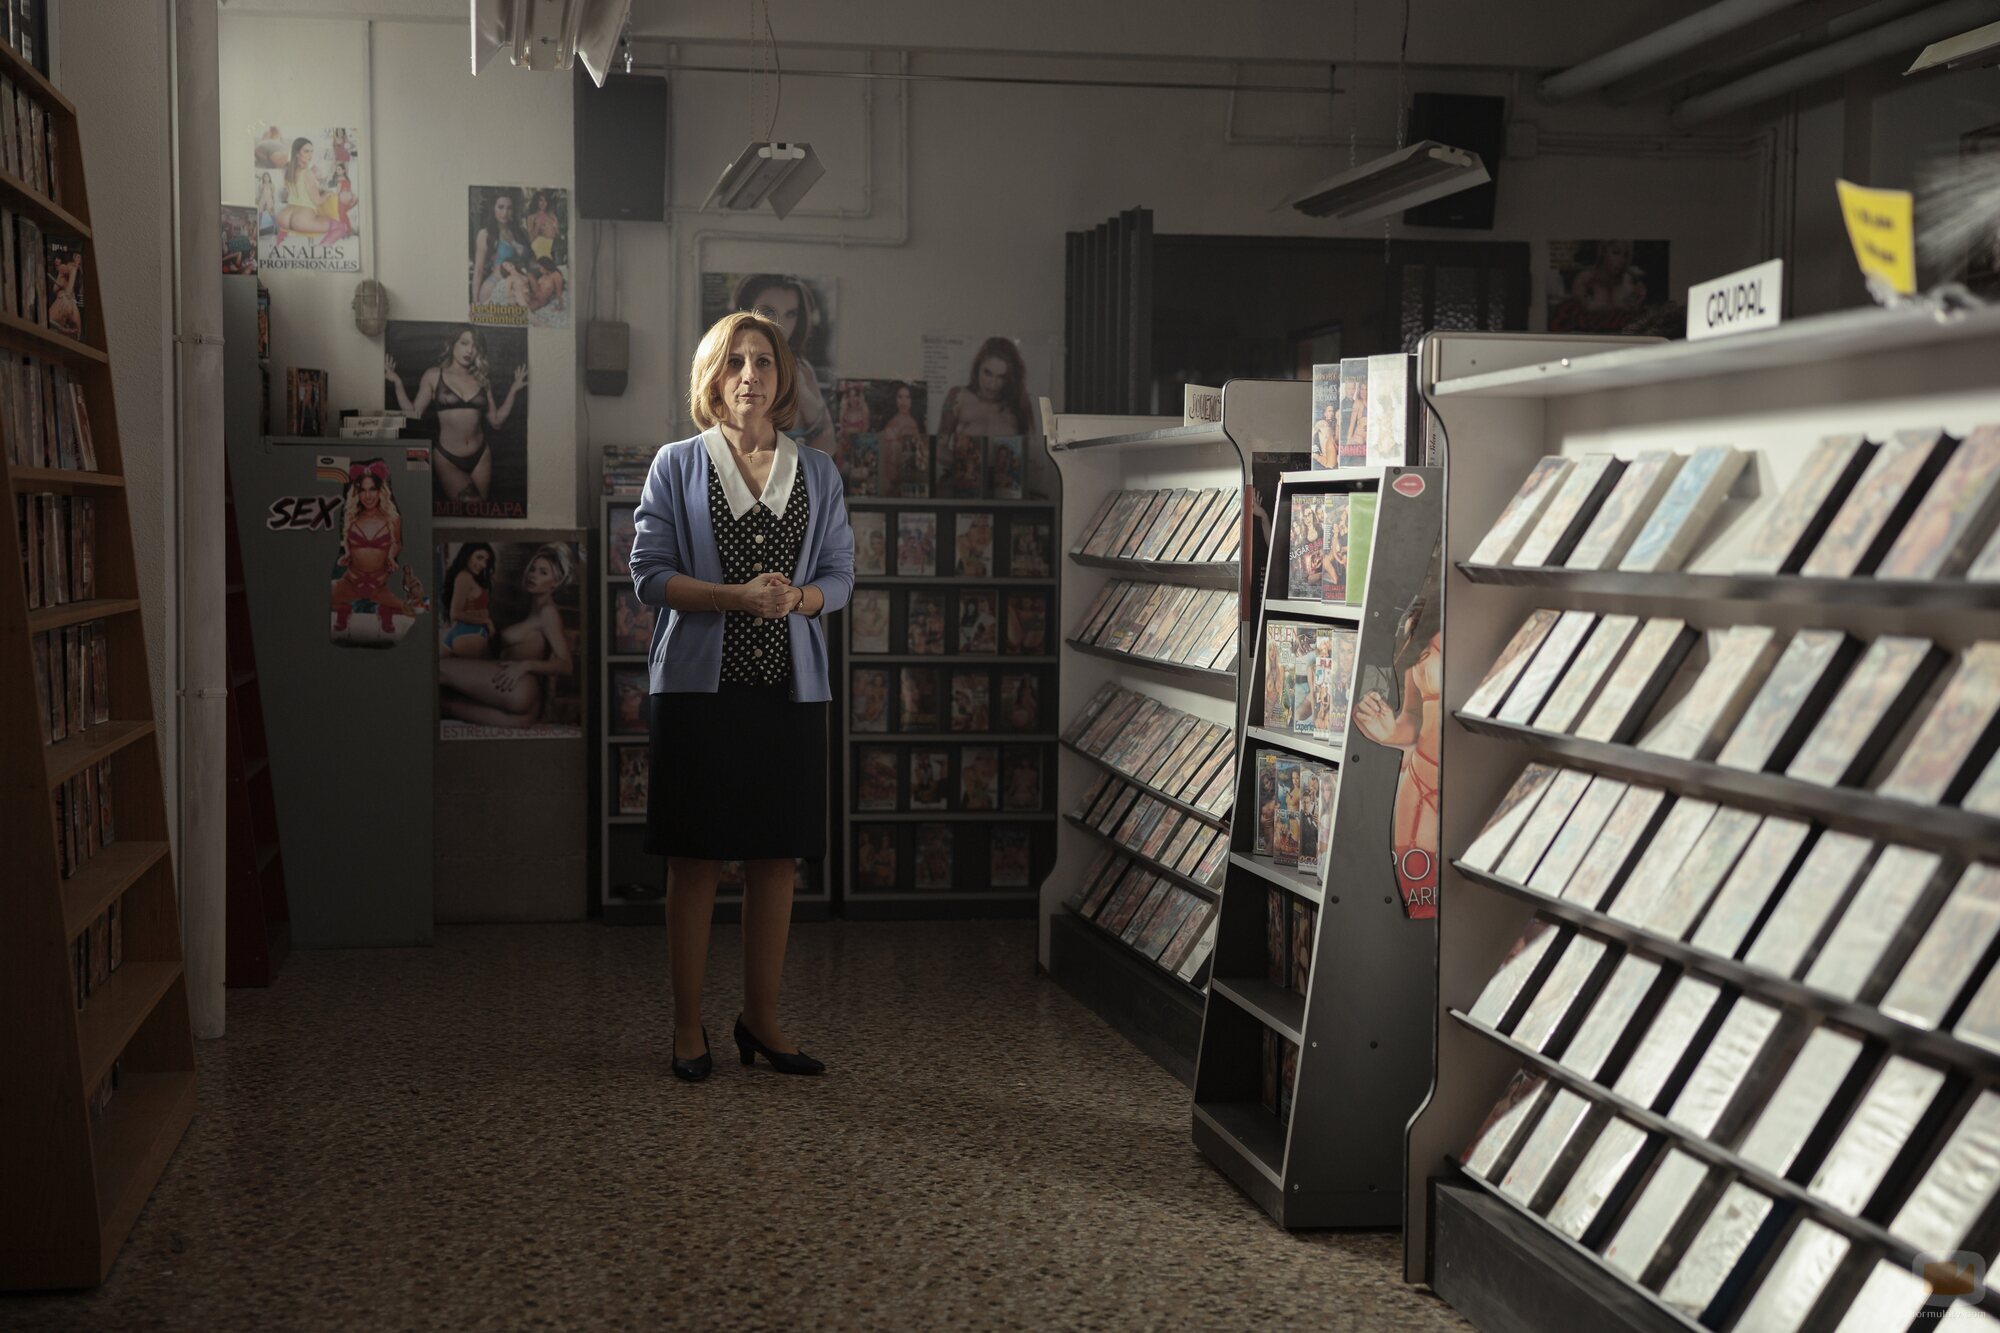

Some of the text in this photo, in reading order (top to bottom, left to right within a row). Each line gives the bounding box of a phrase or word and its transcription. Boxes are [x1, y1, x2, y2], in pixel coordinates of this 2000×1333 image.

[268, 244, 344, 260] ANALES
[258, 258, 358, 270] PROFESIONALES
[1706, 279, 1766, 327] GRUPAL
[270, 497, 342, 529] SEX
[465, 501, 525, 517] GUAPA
[442, 724, 513, 738] ESTRELLAS
